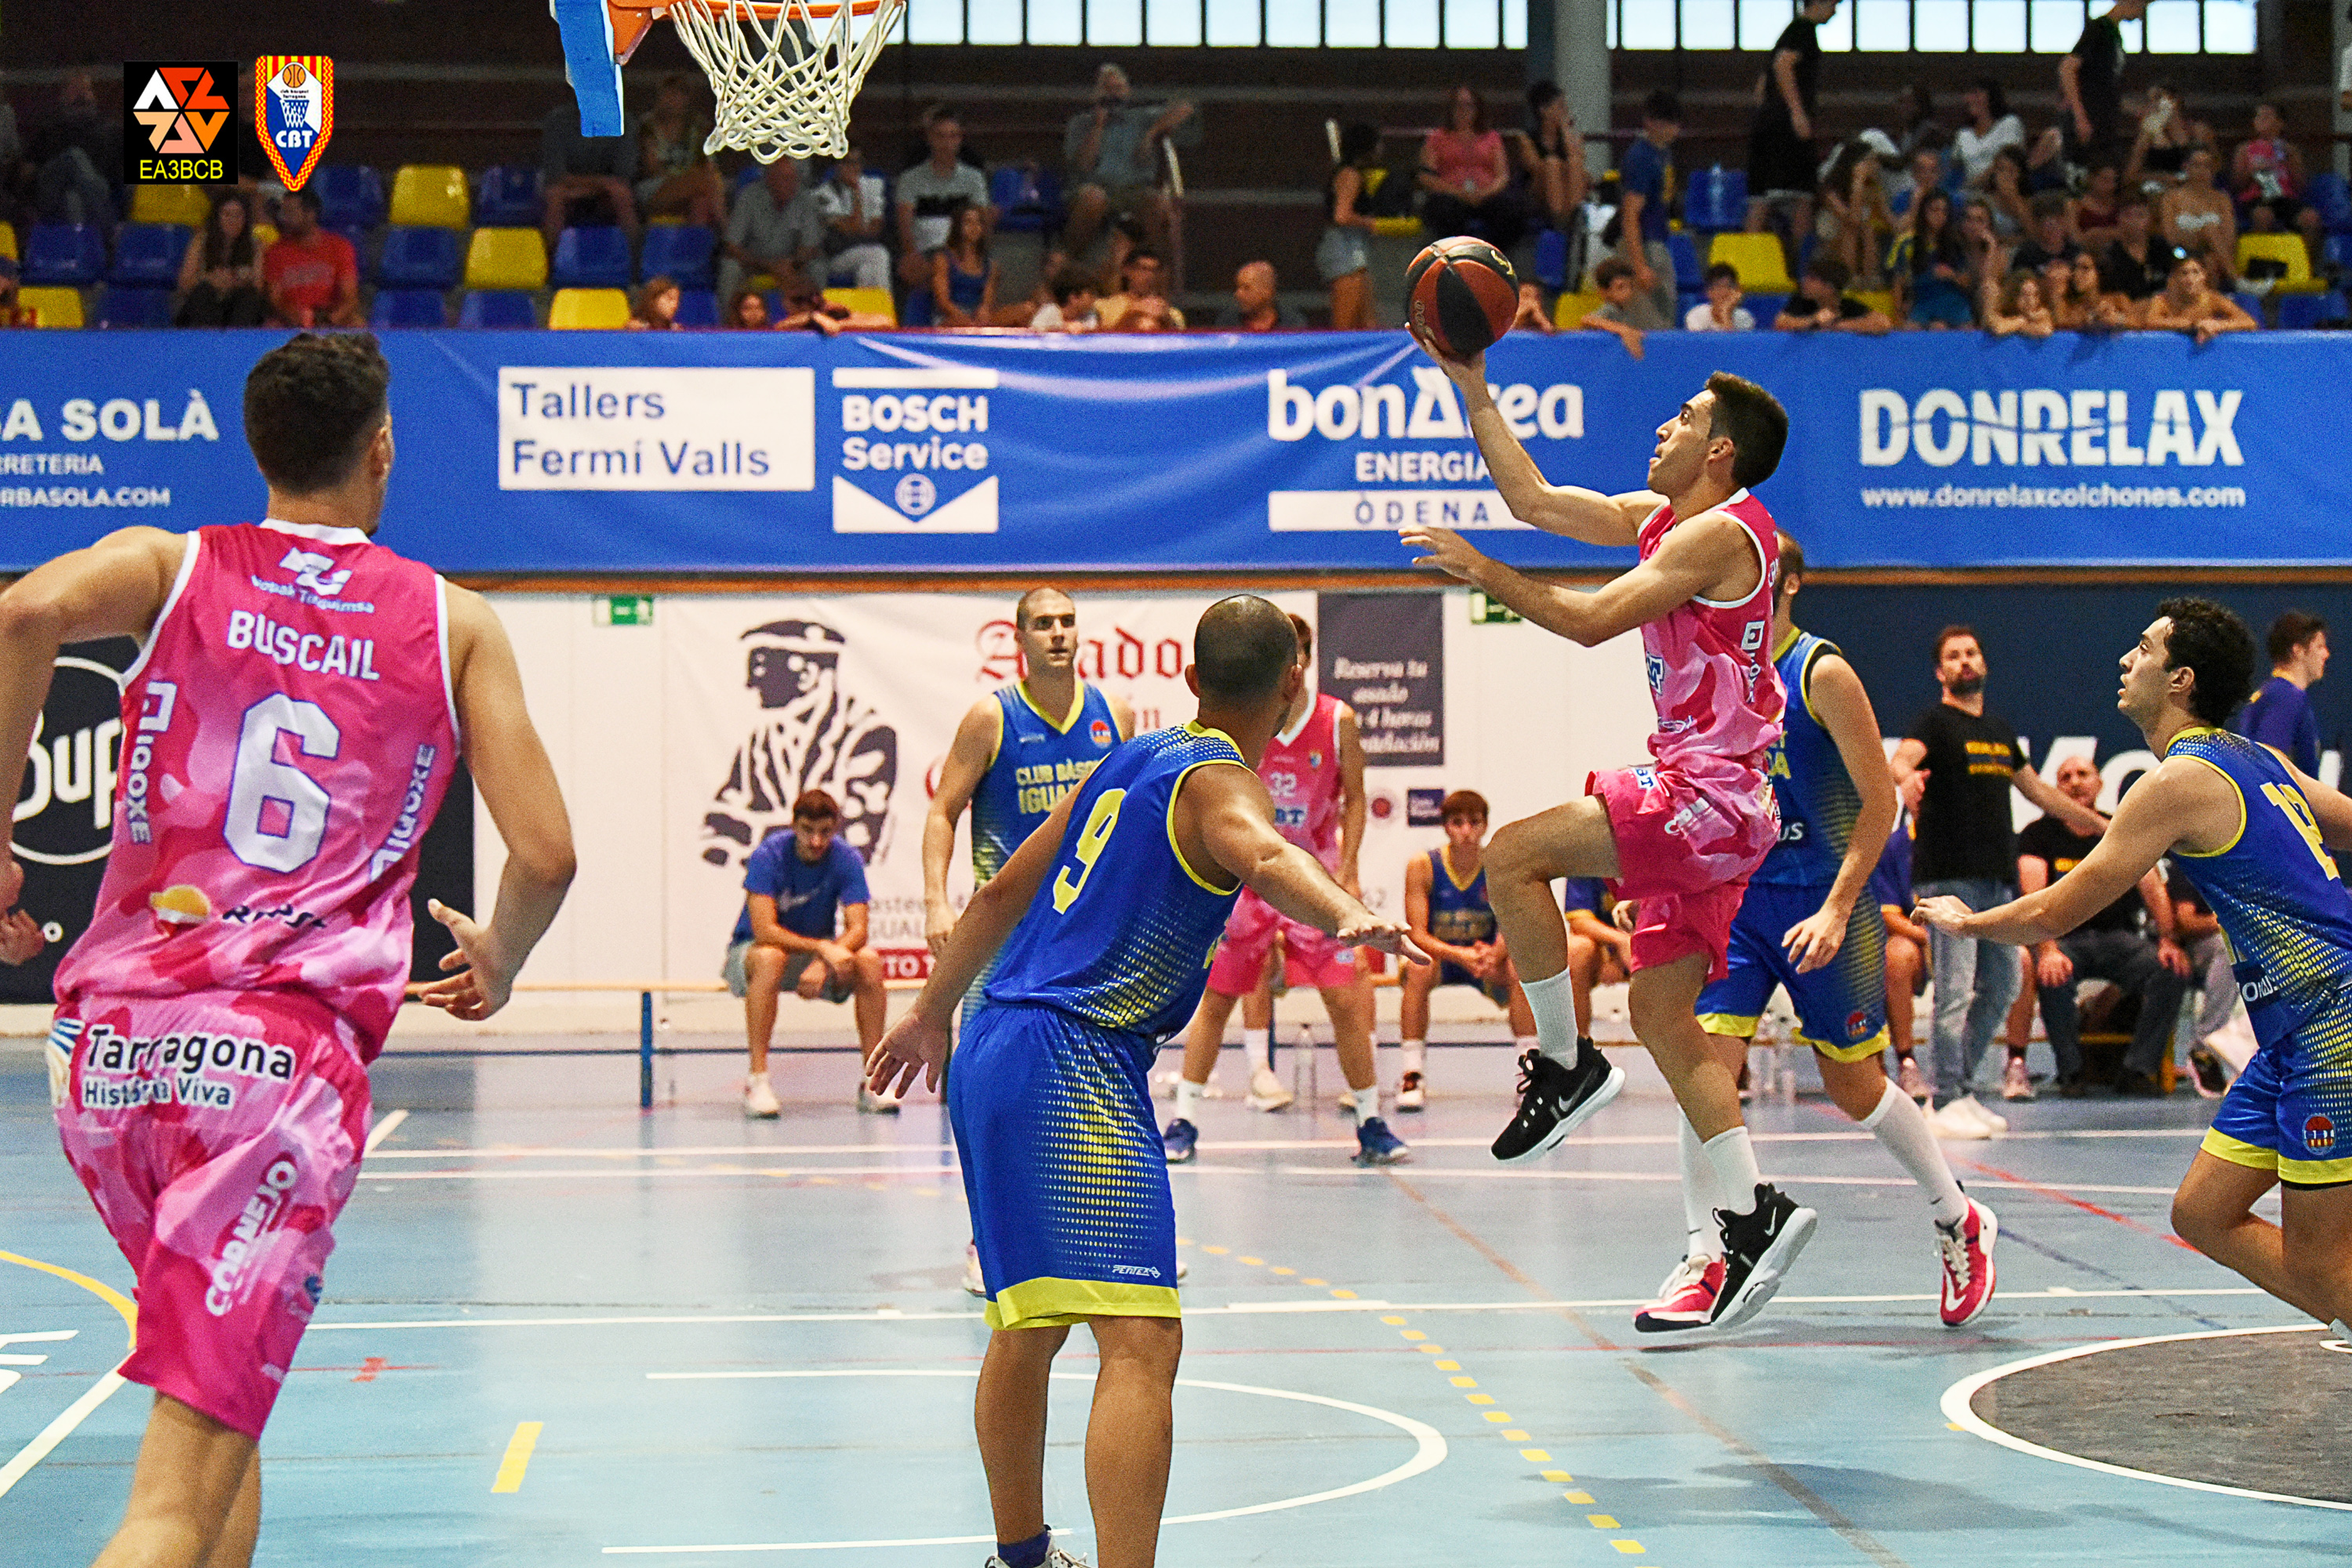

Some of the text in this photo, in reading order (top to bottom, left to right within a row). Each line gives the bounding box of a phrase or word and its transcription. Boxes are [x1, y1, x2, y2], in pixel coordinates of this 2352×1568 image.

[0, 387, 220, 441] A SOLÀ
[510, 382, 665, 419] Tallers
[841, 394, 989, 433] BOSCH
[1268, 366, 1584, 441] bonAea
[1859, 388, 2245, 466] DONRELAX
[512, 437, 771, 476] Fermí Valls
[841, 436, 989, 470] Service
[1355, 492, 1490, 525] ÒDENA
[1860, 481, 2246, 509] www.donrelaxcolchones.com
[226, 610, 380, 681] BUSCAIL
[223, 691, 342, 874] 6
[1270, 772, 1297, 797] 32
[1052, 787, 1127, 915] 9
[86, 1027, 294, 1080] Tarragona
[177, 1076, 232, 1105] Viva
